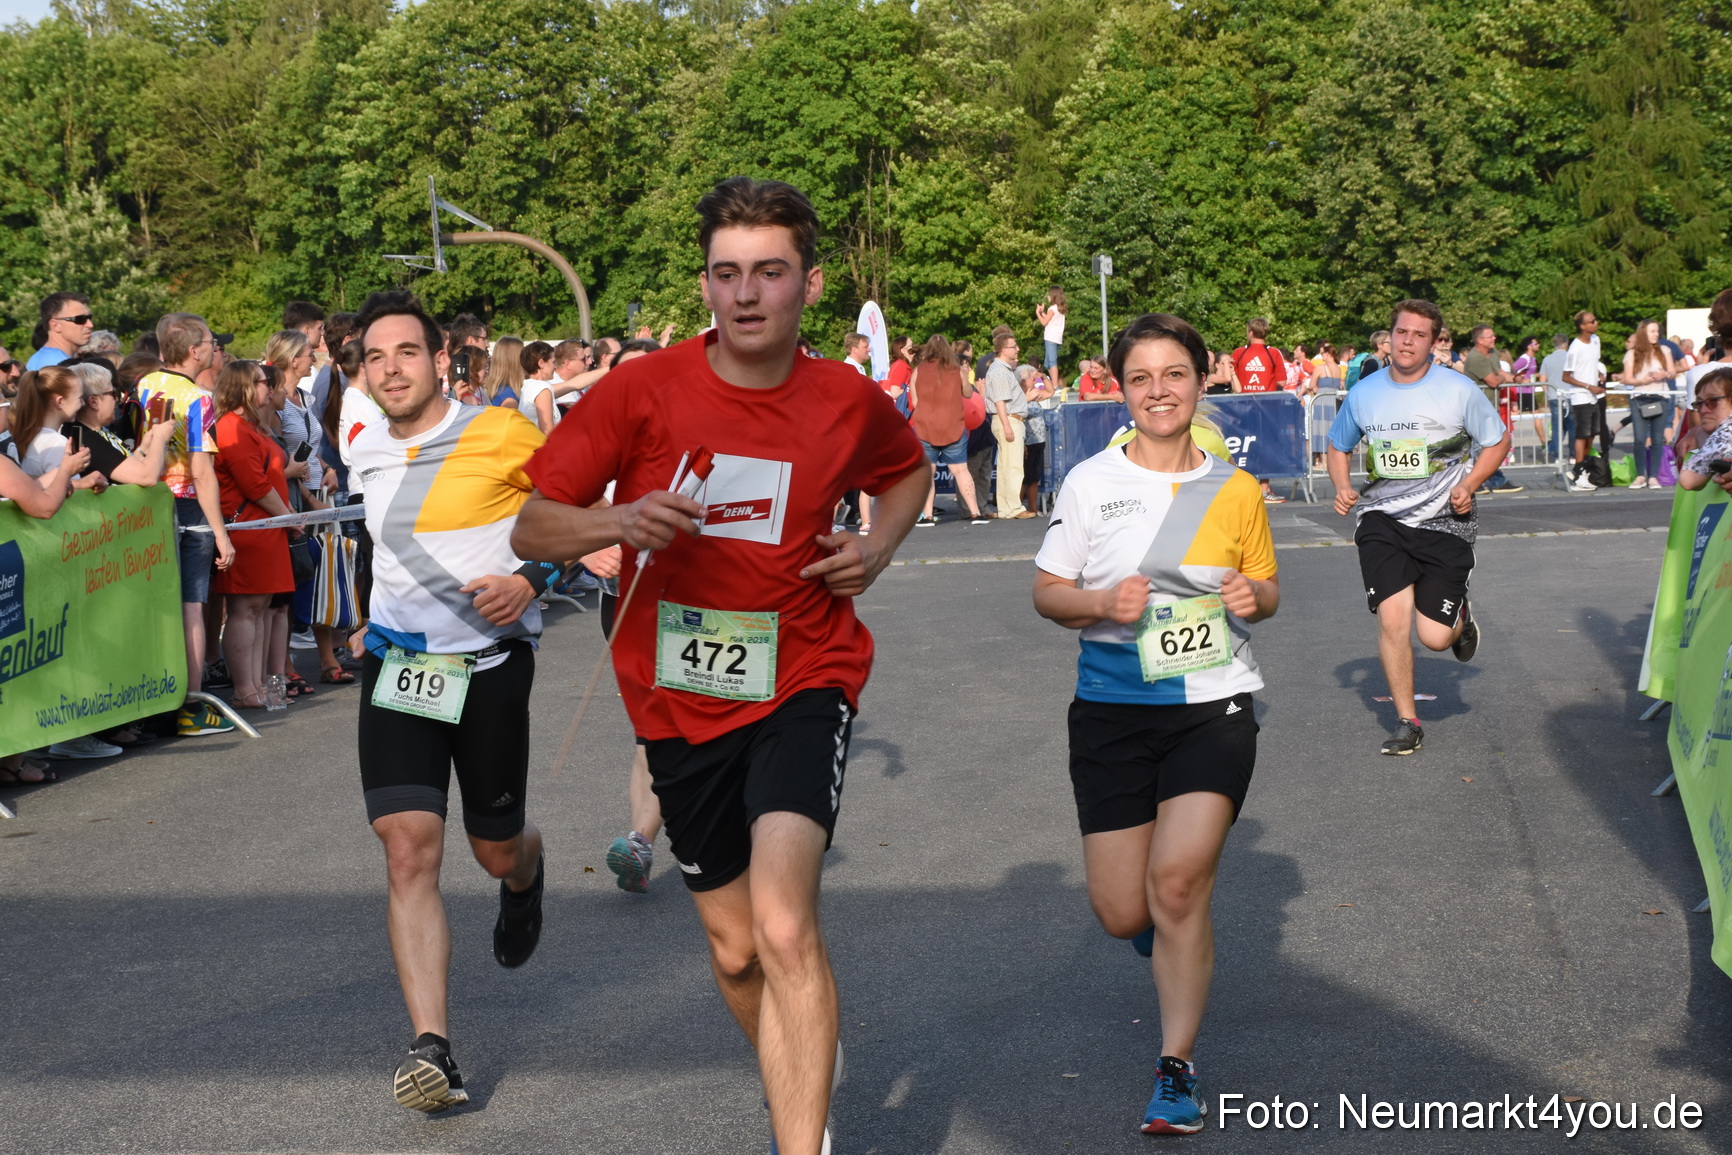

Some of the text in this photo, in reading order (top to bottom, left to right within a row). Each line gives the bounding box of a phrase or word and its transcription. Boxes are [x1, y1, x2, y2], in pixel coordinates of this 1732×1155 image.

[1380, 453, 1420, 468] 1946
[723, 505, 754, 518] DEHN
[1100, 499, 1141, 512] DESSIGN
[1102, 507, 1134, 521] GROUP
[61, 505, 154, 563] Gesunde Firmen
[85, 529, 169, 595] laufen länger!
[747, 636, 770, 644] 2019
[1160, 623, 1213, 656] 622
[680, 638, 747, 676] 472
[1156, 648, 1221, 667] Schneider Johanna
[397, 667, 445, 699] 619
[447, 669, 465, 679] 2019
[683, 668, 745, 686] Breindl Lukas
[36, 668, 178, 729] www.firmenlauf-oberpfalz.de
[393, 691, 441, 707] Fuchs Michael
